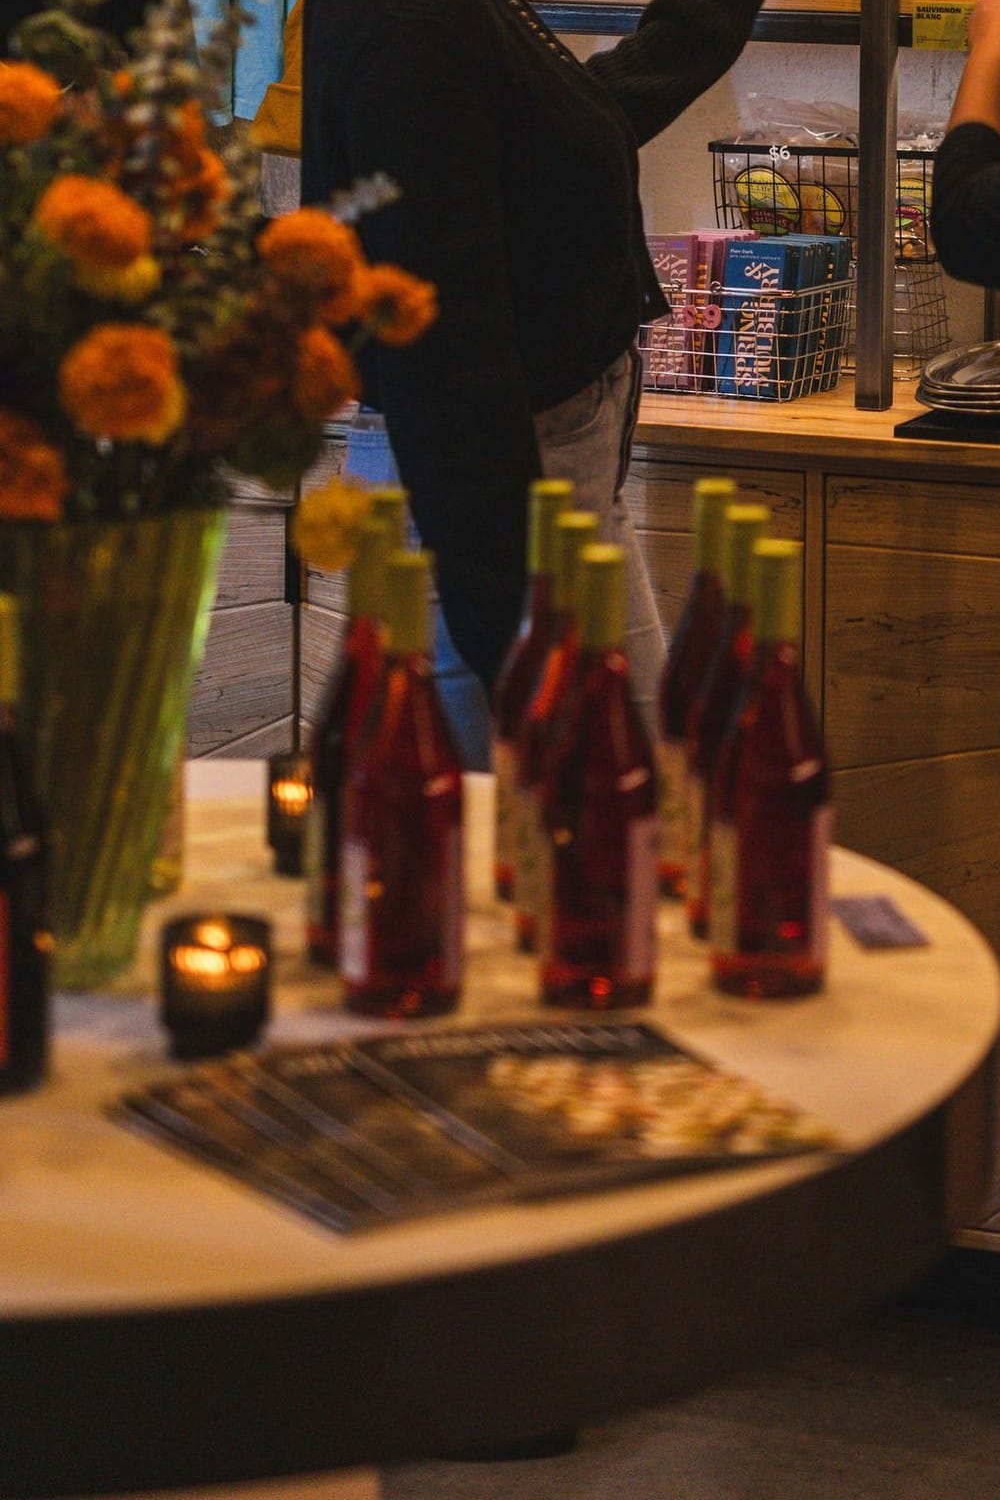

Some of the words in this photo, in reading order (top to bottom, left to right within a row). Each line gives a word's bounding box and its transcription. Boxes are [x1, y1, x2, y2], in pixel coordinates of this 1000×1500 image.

[916, 6, 961, 14] SAUVIGNON
[769, 145, 791, 160] $6
[735, 301, 758, 387] SPRING
[752, 262, 779, 388] MULBERRY
